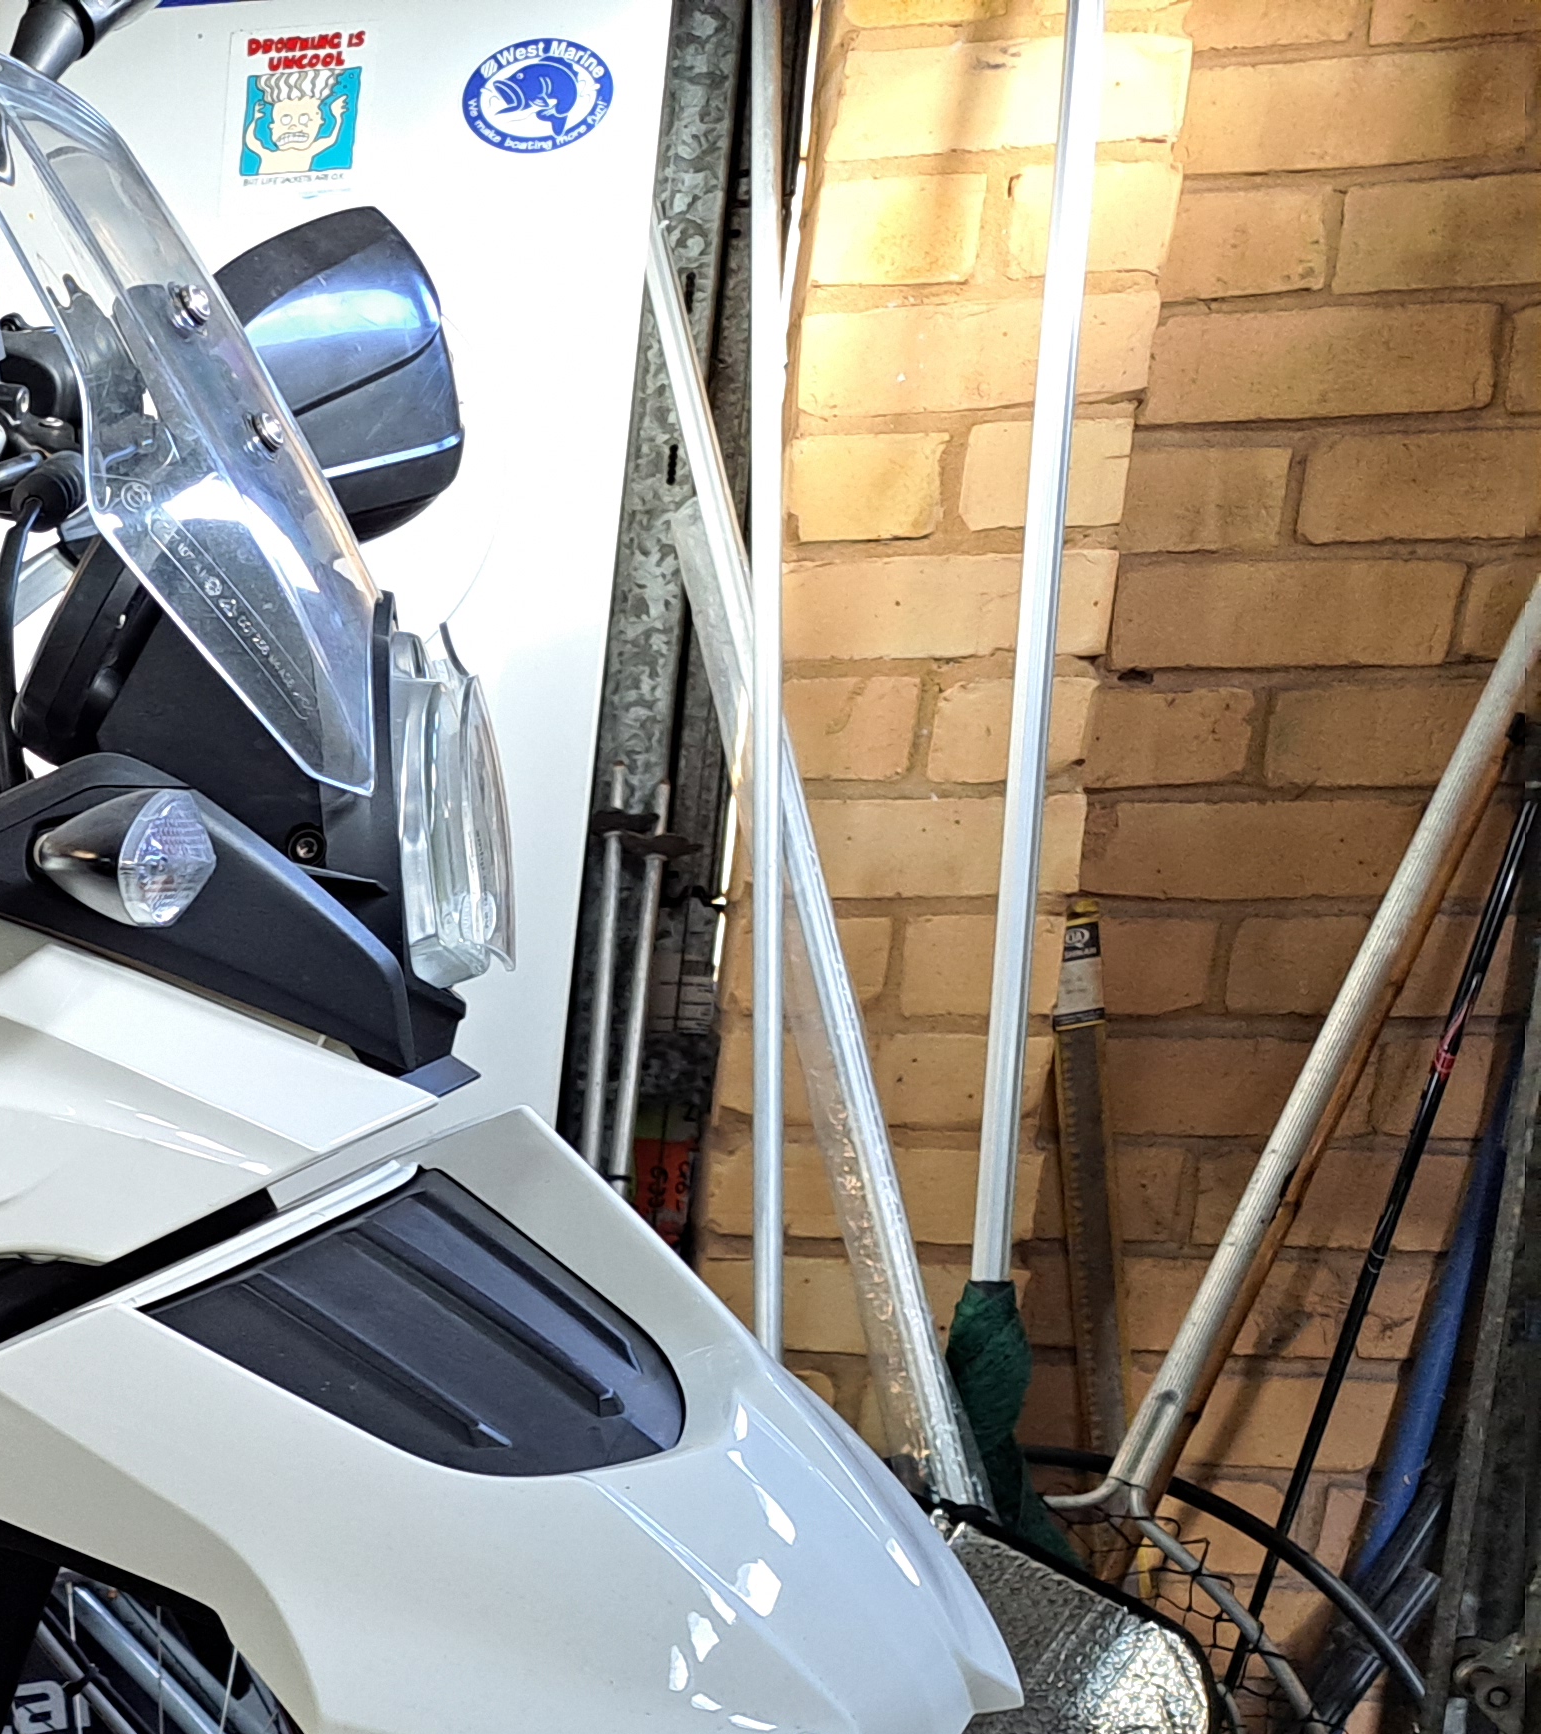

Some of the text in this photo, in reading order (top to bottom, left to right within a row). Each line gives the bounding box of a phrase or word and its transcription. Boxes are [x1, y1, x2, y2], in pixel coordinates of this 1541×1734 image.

[247, 30, 366, 57] DROWNING IS
[268, 51, 346, 72] UNCOOL
[497, 41, 605, 79] West Marine
[467, 98, 479, 118] We
[473, 119, 502, 144] make
[504, 137, 553, 150] boating
[556, 124, 588, 145] more
[261, 175, 279, 186] LIFE
